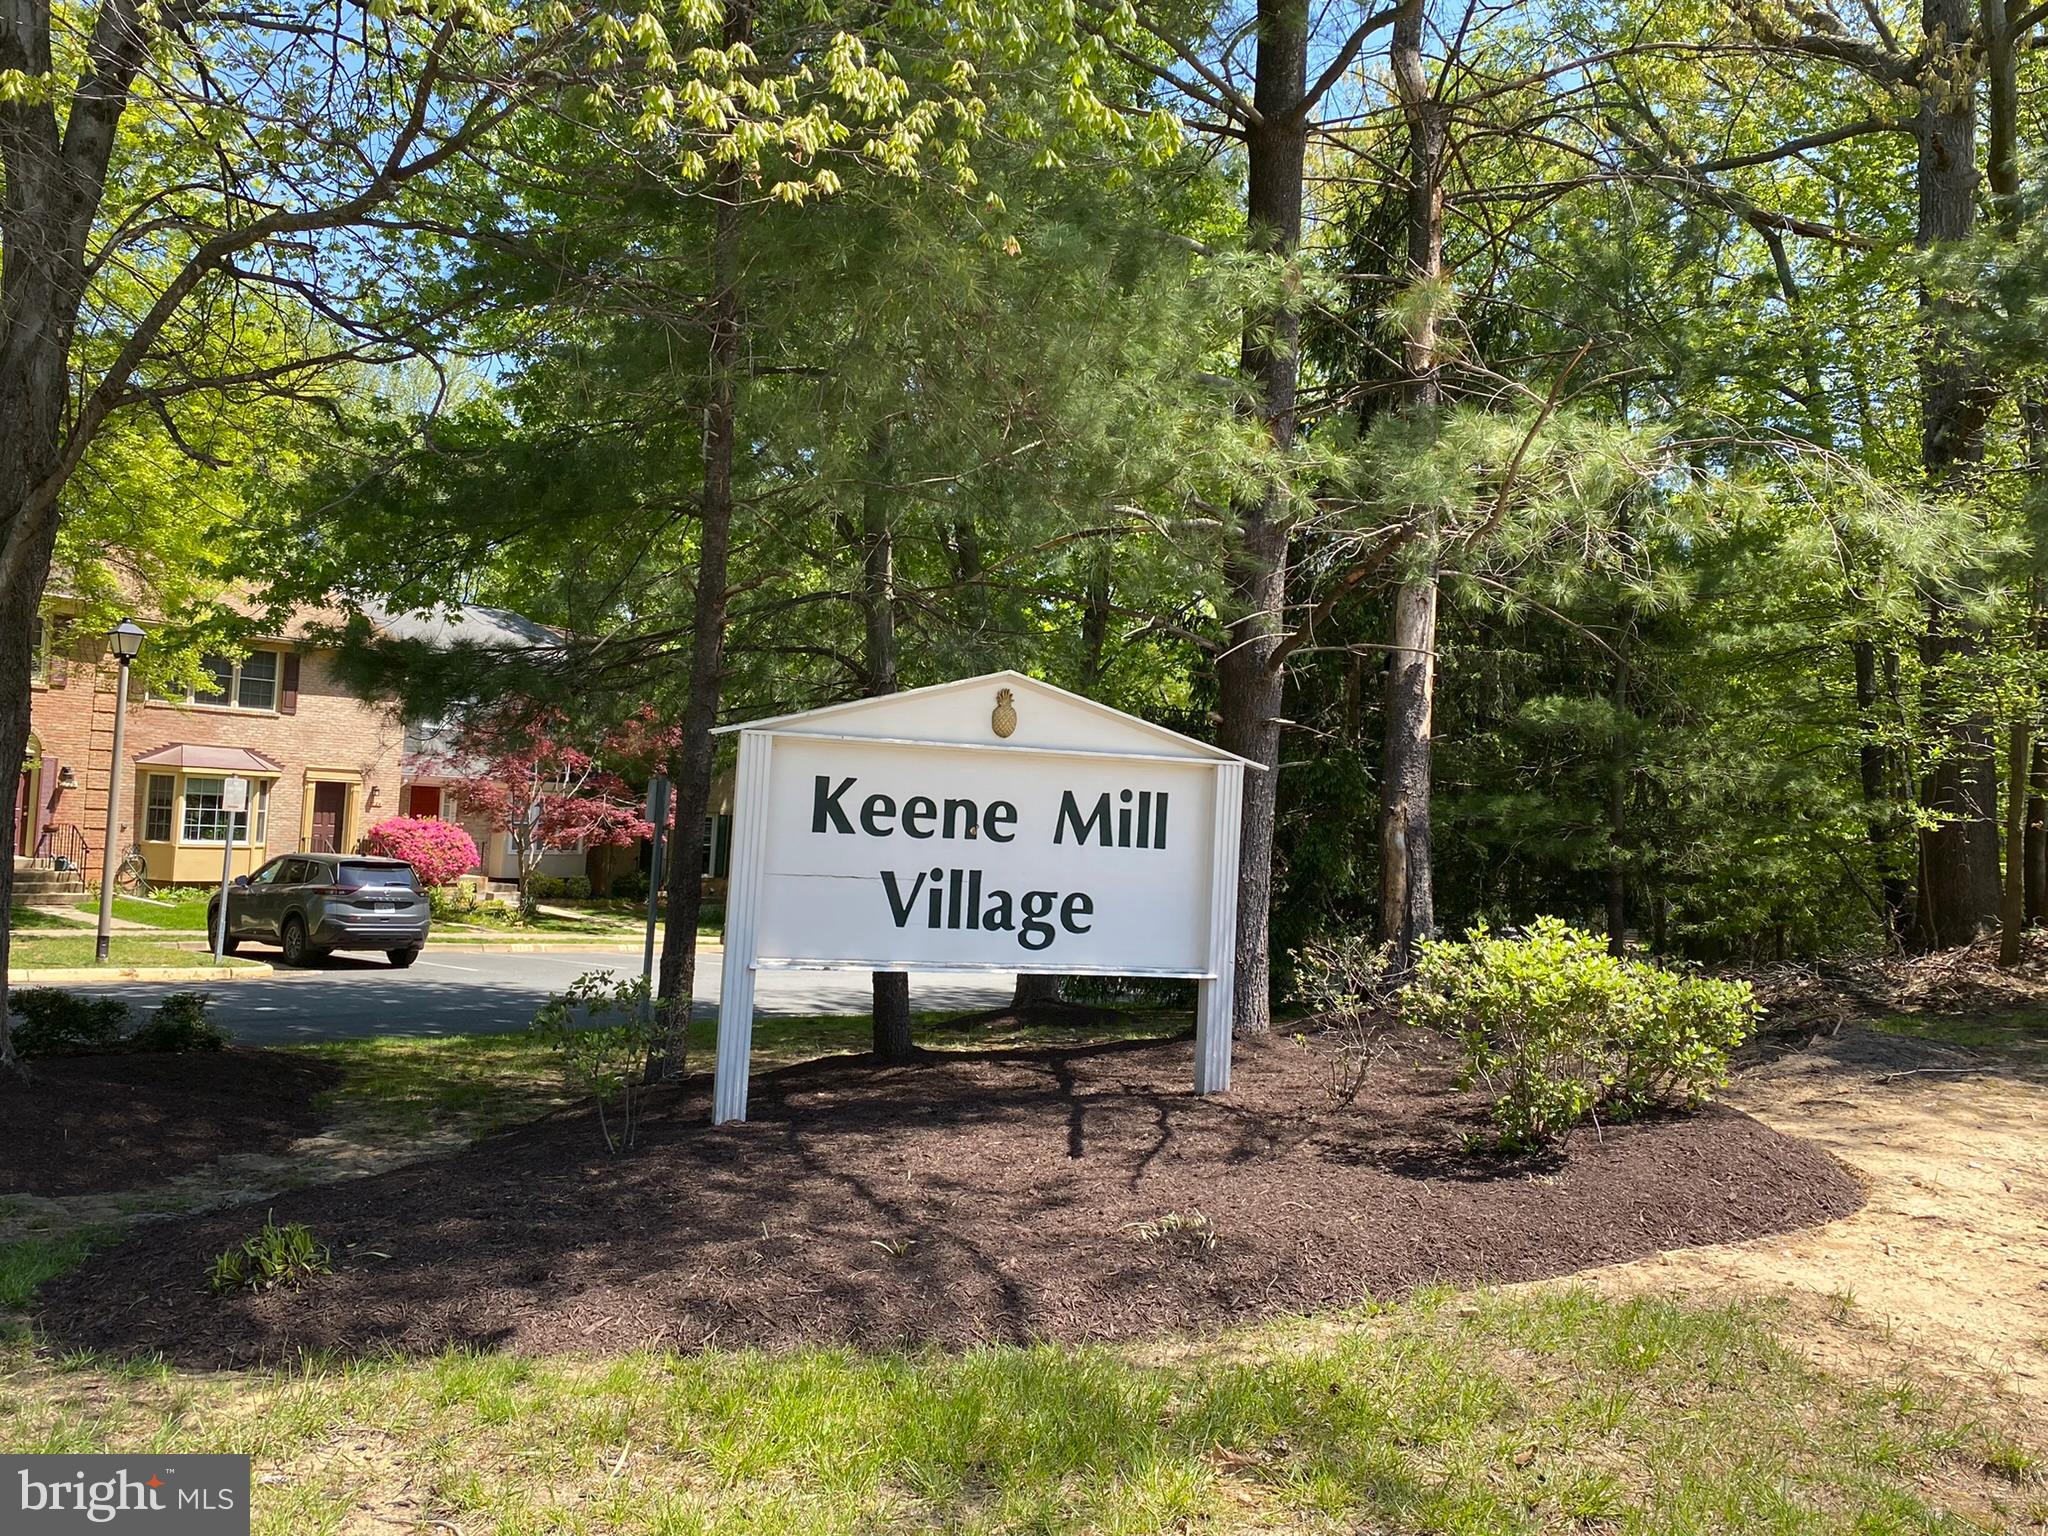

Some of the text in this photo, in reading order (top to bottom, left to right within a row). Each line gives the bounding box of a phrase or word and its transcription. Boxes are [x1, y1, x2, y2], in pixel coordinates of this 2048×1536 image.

[811, 775, 1169, 850] Keene Mill
[880, 867, 1094, 951] Village
